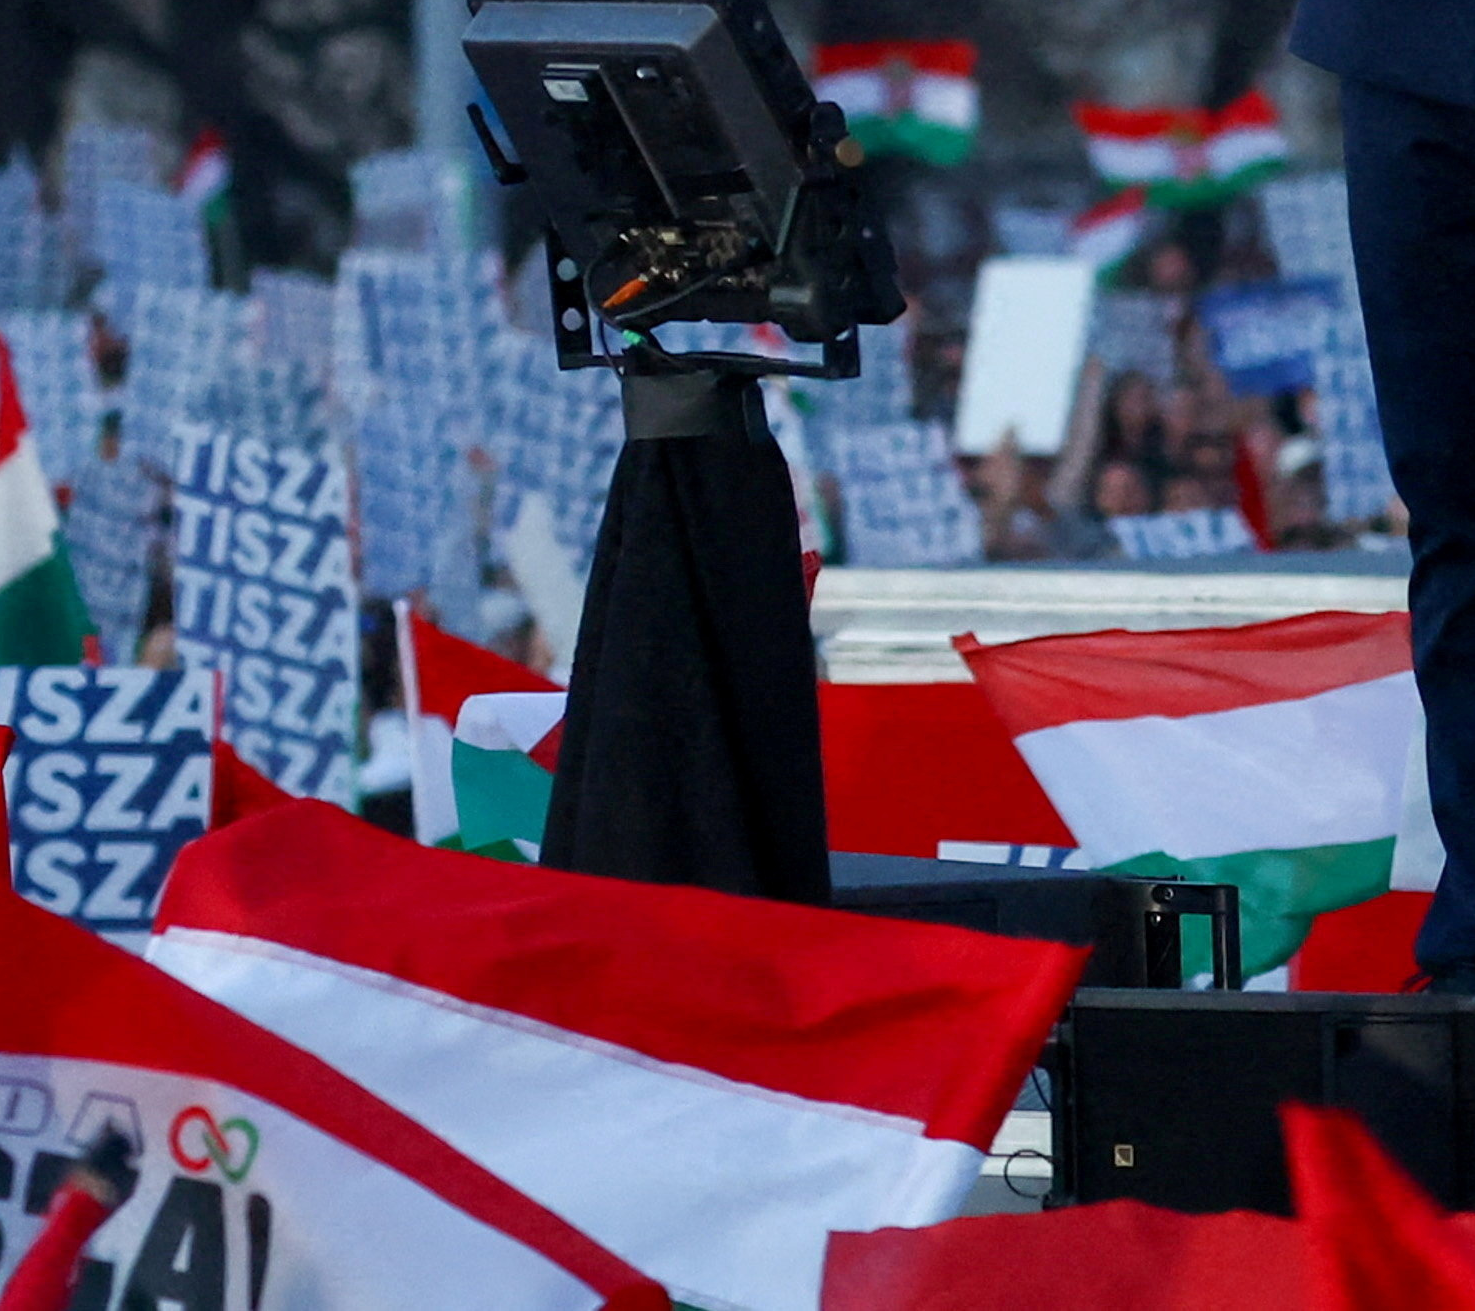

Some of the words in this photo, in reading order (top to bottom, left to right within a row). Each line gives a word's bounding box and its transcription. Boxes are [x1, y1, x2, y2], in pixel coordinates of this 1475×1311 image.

[172, 423, 349, 520] TISZA
[173, 490, 353, 592] TISZA
[175, 564, 359, 667] TISZA
